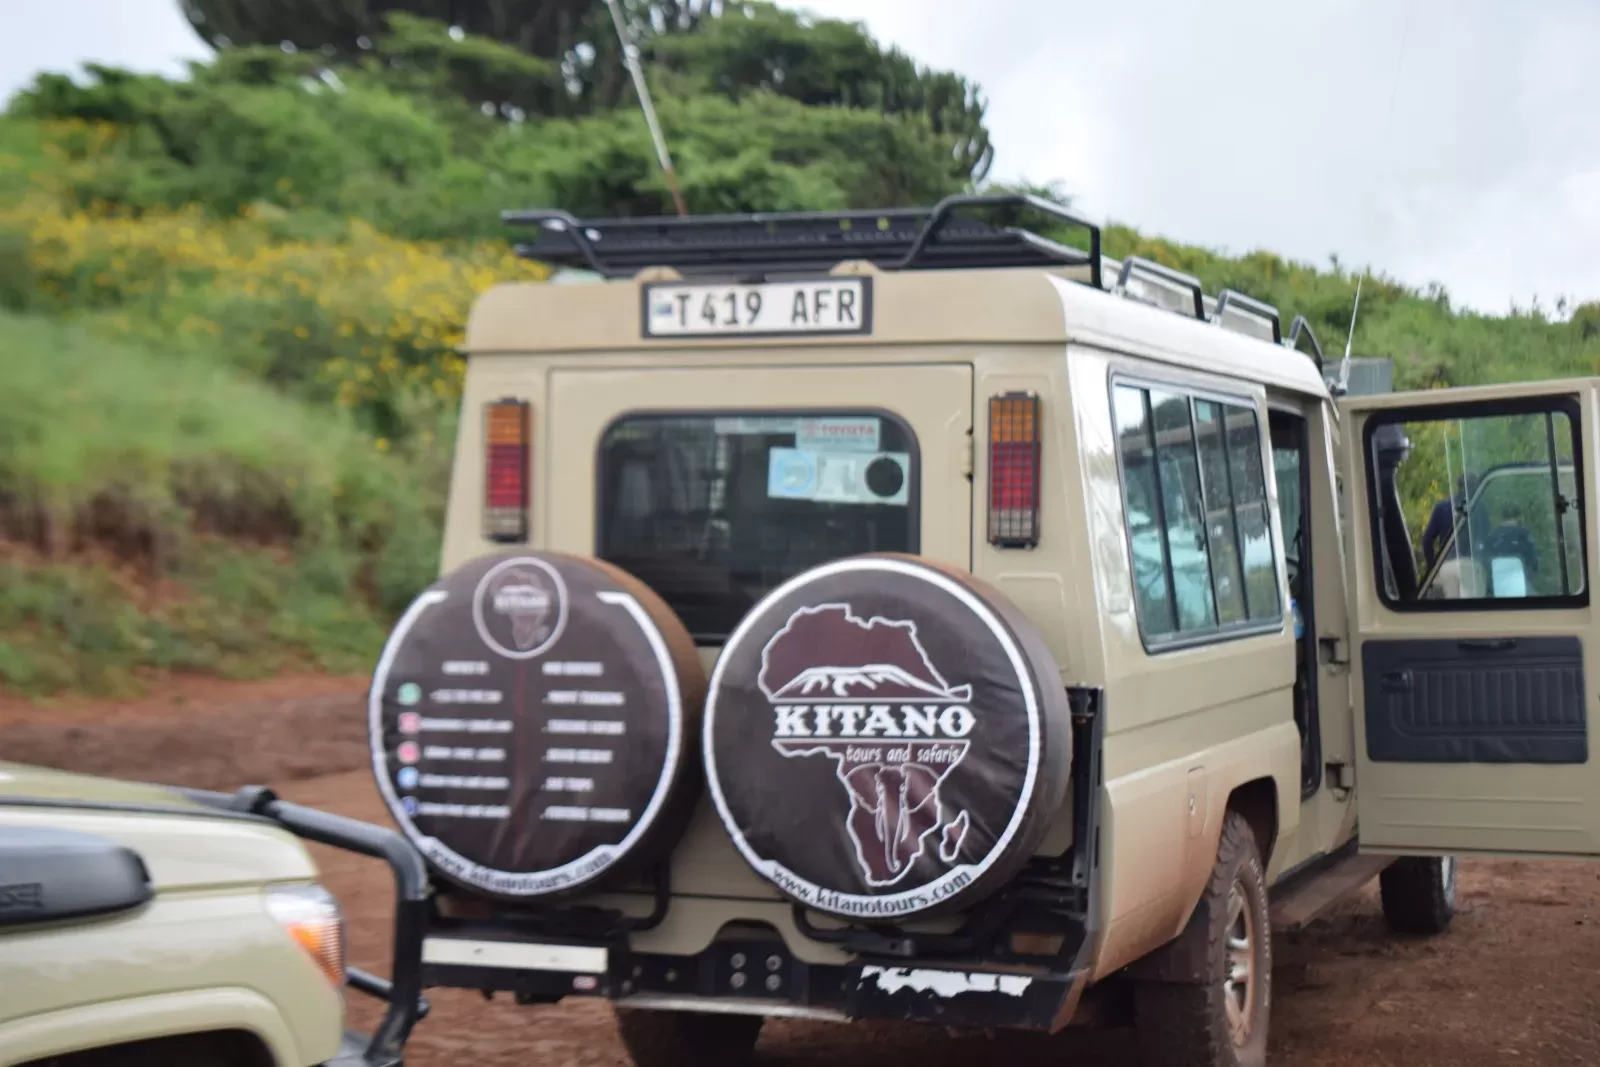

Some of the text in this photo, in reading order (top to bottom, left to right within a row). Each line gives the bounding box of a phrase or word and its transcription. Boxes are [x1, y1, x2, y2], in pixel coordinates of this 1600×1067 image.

[791, 289, 855, 323] AFR
[774, 704, 977, 738] KITANO
[846, 742, 961, 764] tours and safaris
[772, 869, 972, 915] www.kitanotours.com
